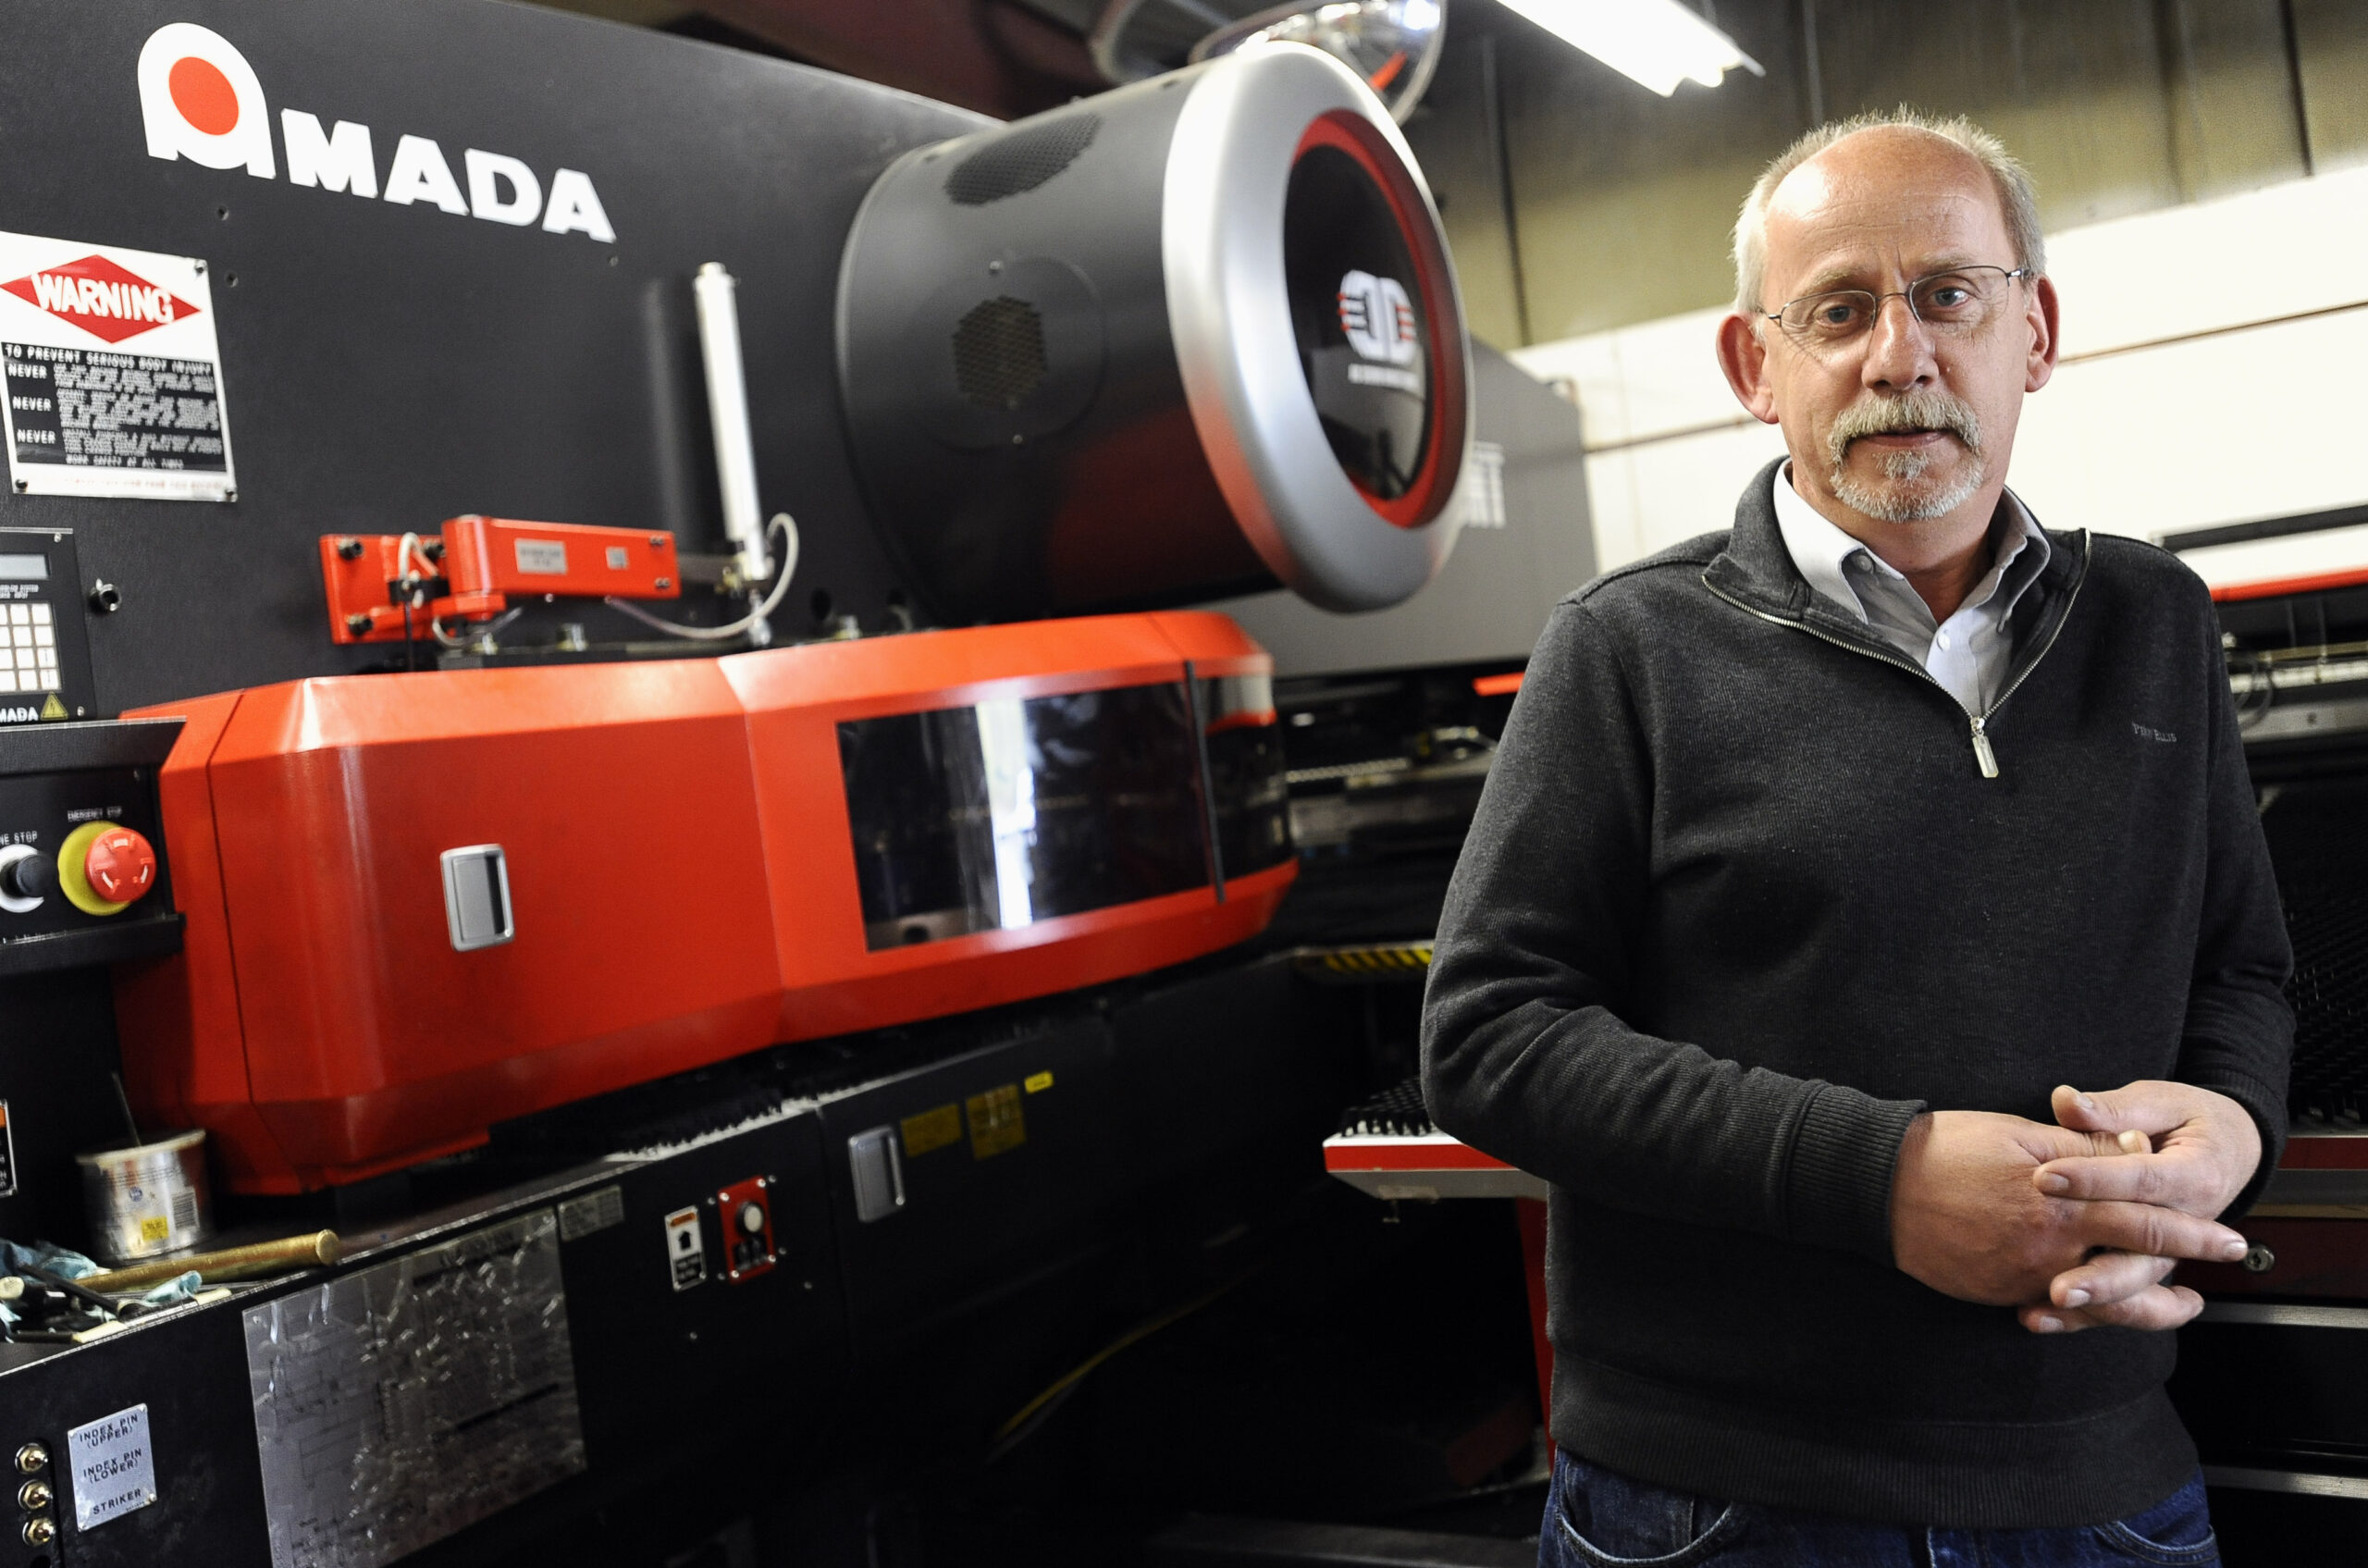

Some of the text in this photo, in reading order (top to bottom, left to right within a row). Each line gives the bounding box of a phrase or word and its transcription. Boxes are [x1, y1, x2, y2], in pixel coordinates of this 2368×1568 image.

[31, 273, 175, 323] WARNING
[5, 343, 211, 376] TO PREVENT SERIOUS BODY INJURY
[7, 363, 47, 379] NEVER
[12, 396, 51, 412] NEVER
[17, 428, 56, 444] NEVER
[14, 831, 38, 845] STOP
[80, 1414, 138, 1442] INDEX PIN
[88, 1425, 133, 1449] (UPPER)
[83, 1448, 142, 1477] INDEX PIN
[90, 1458, 138, 1484] (LOWER)
[92, 1488, 142, 1514] STRIKER
